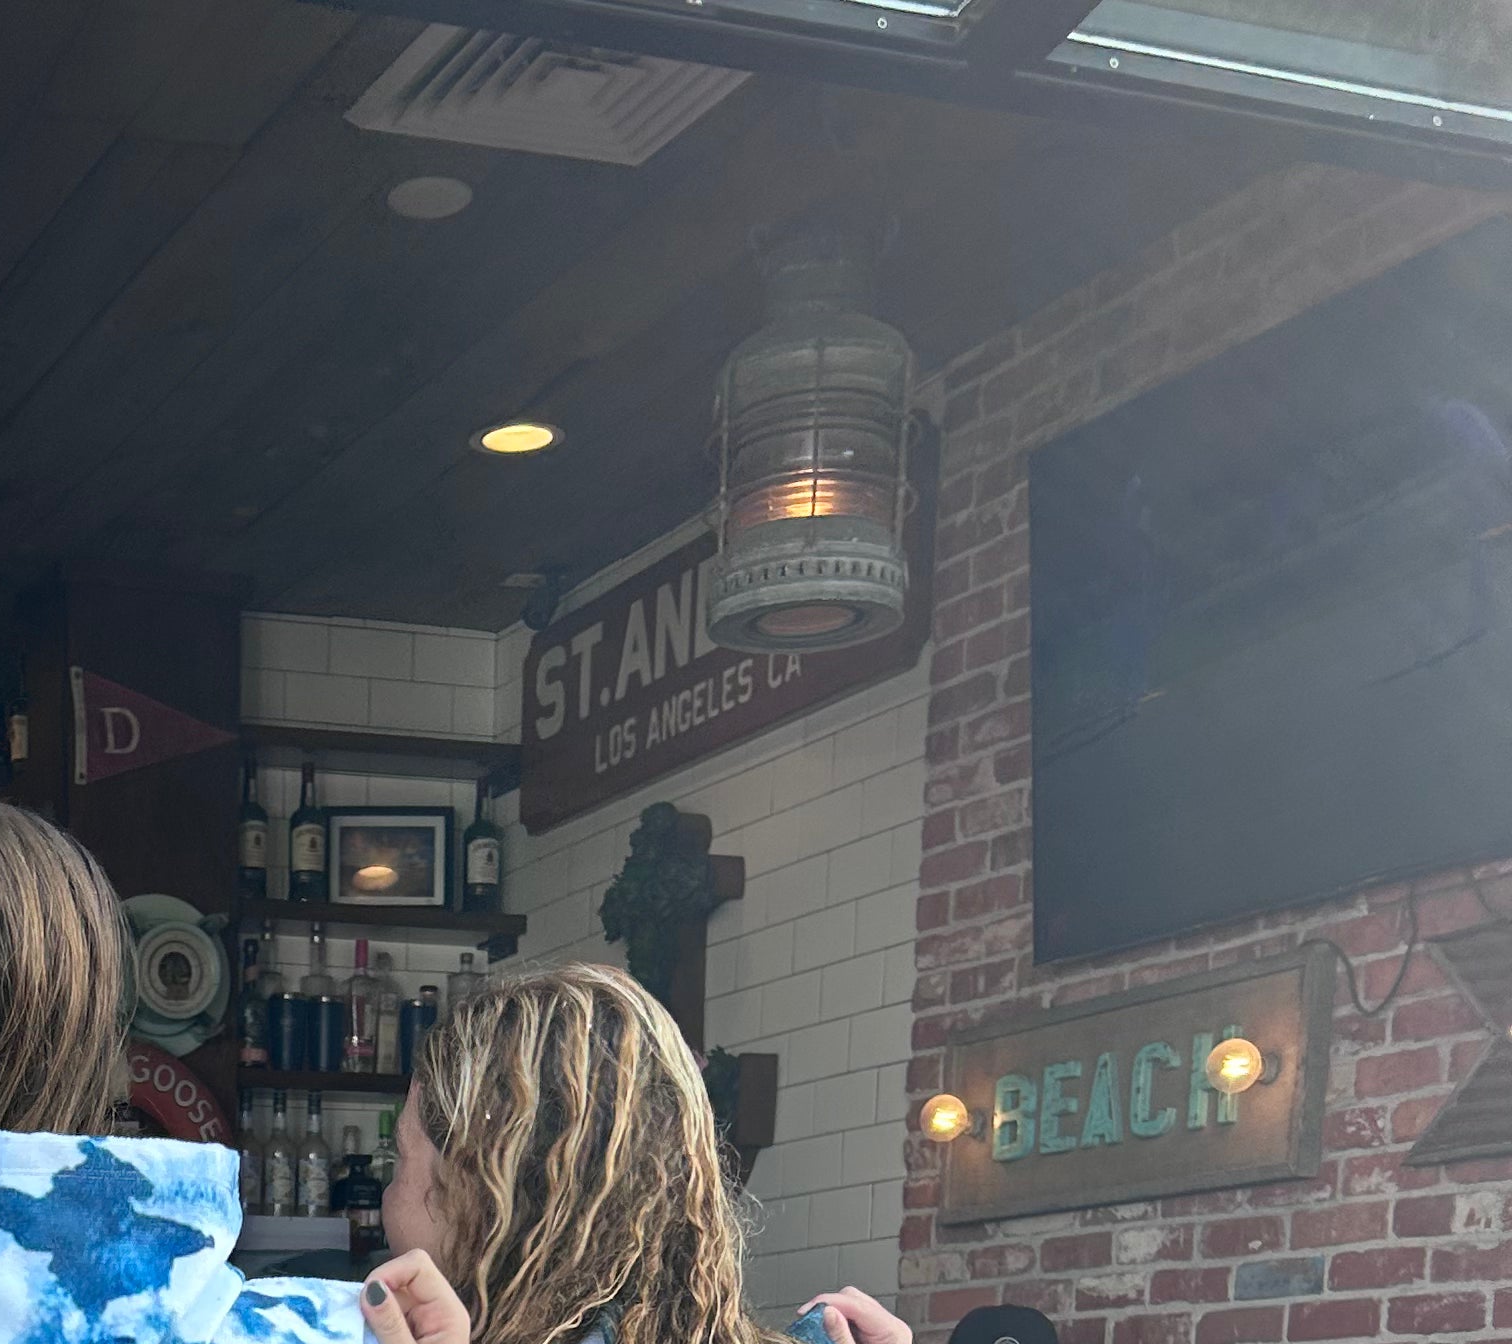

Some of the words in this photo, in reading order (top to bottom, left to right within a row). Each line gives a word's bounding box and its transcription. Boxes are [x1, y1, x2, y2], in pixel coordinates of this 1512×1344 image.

[102, 705, 141, 755] D
[594, 717, 639, 774] LOS
[645, 659, 753, 751] ANGELES
[130, 1054, 222, 1142] GOOSE
[991, 1024, 1245, 1162] BEACH
